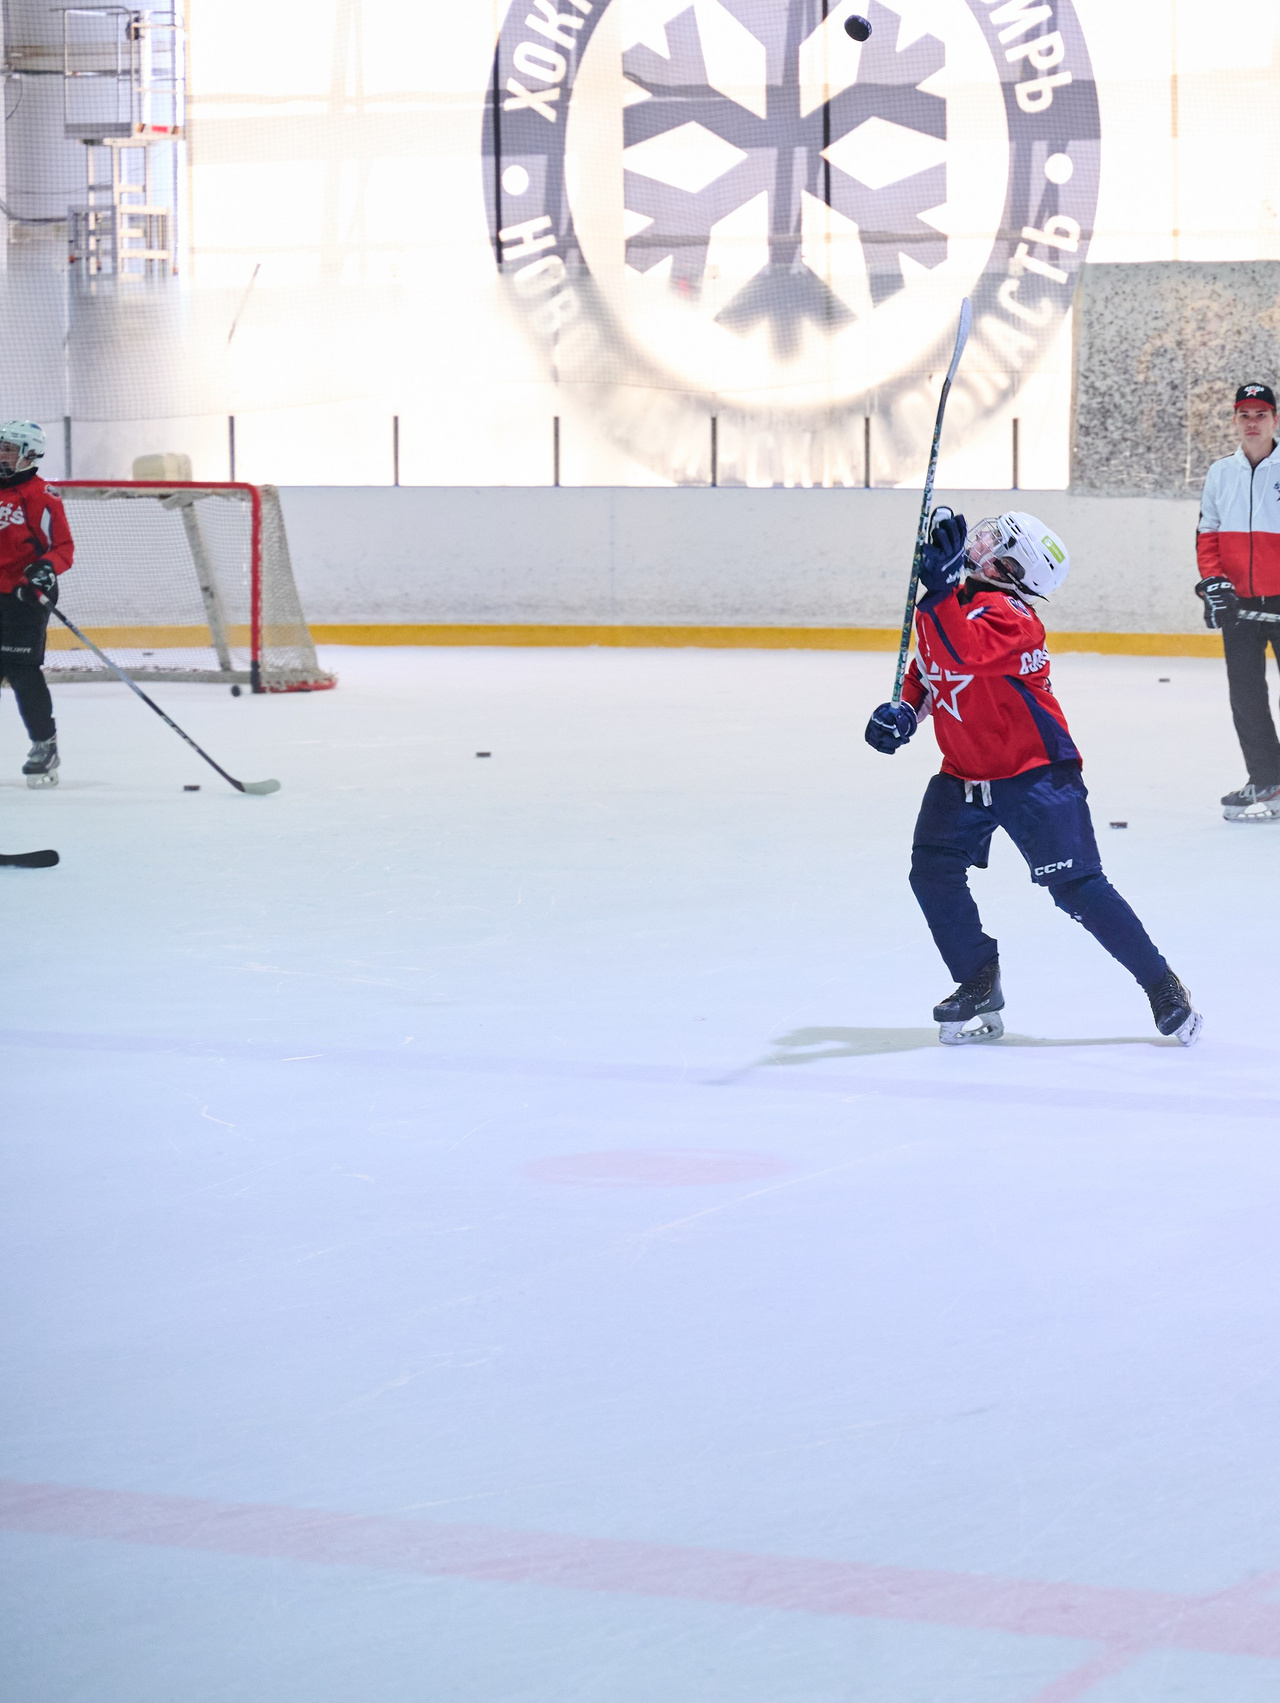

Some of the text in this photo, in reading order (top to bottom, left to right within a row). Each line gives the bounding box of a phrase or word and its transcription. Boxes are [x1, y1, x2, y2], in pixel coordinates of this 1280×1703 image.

[982, 0, 1073, 114] ИРЬ
[1206, 581, 1236, 593] CC
[1034, 858, 1074, 876] CCM
